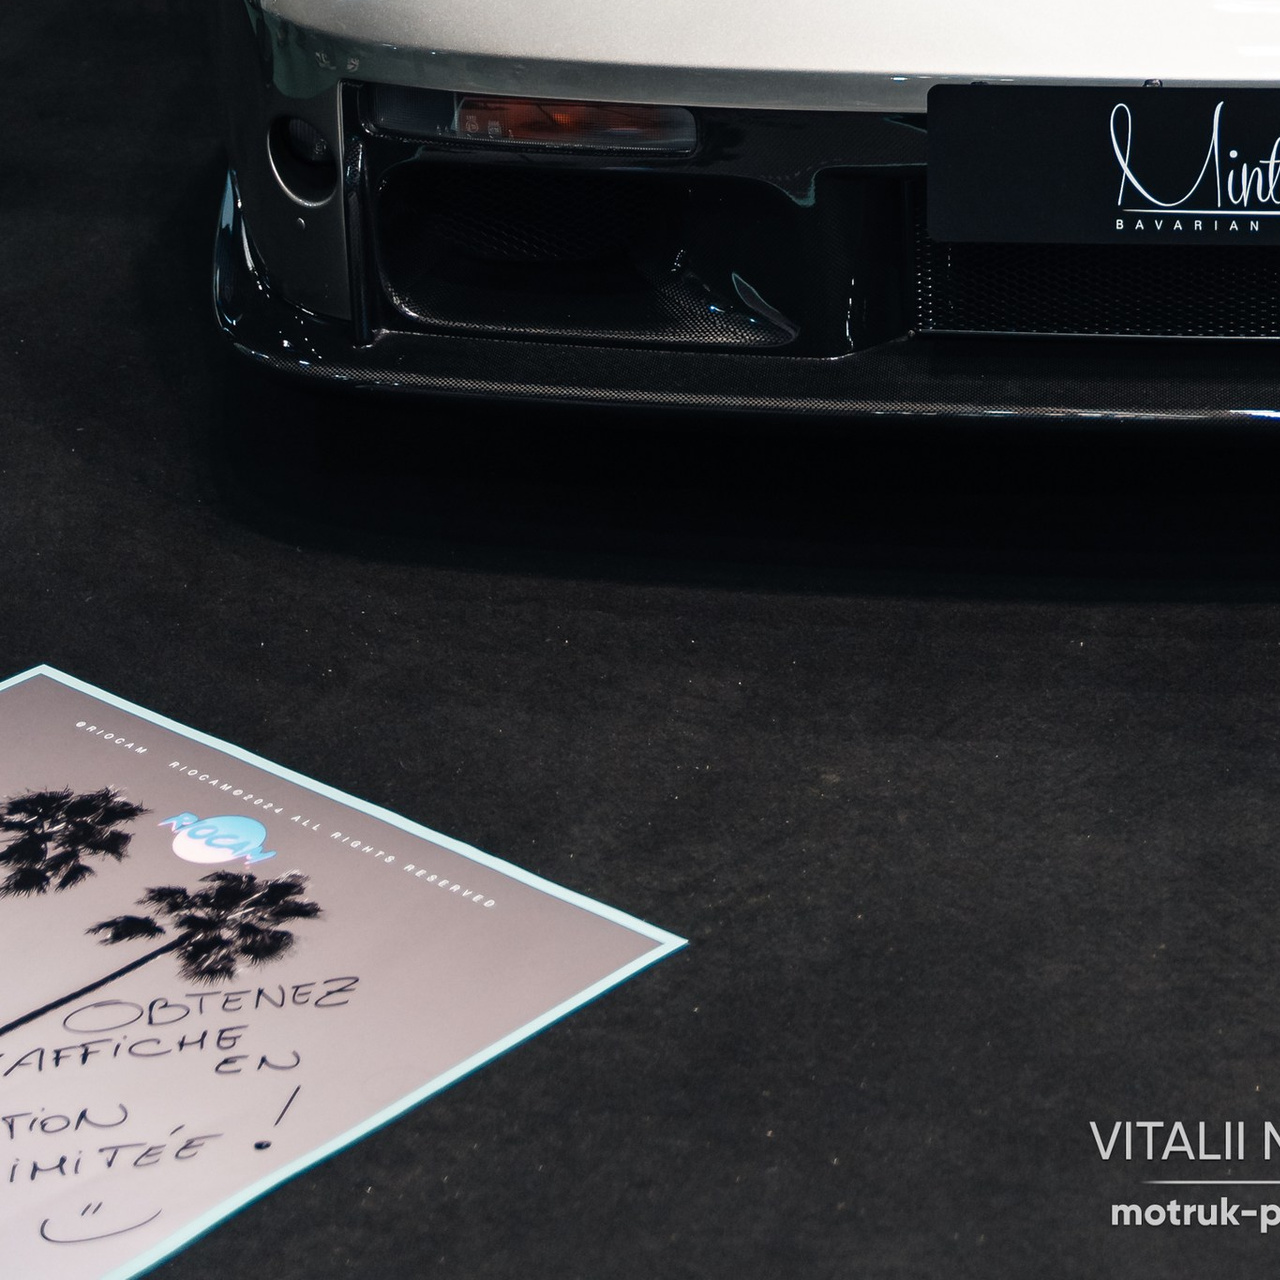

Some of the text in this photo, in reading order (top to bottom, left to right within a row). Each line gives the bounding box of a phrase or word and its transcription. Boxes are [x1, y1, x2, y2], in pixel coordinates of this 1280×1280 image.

[1115, 219, 1260, 232] BAVARIAN
[158, 810, 277, 866] RIOCAM
[290, 814, 320, 832] ALL
[330, 830, 395, 864] RIGHTS
[403, 863, 497, 910] RESERVED
[63, 976, 360, 1033] OBTENEZ
[215, 1050, 301, 1074] EN
